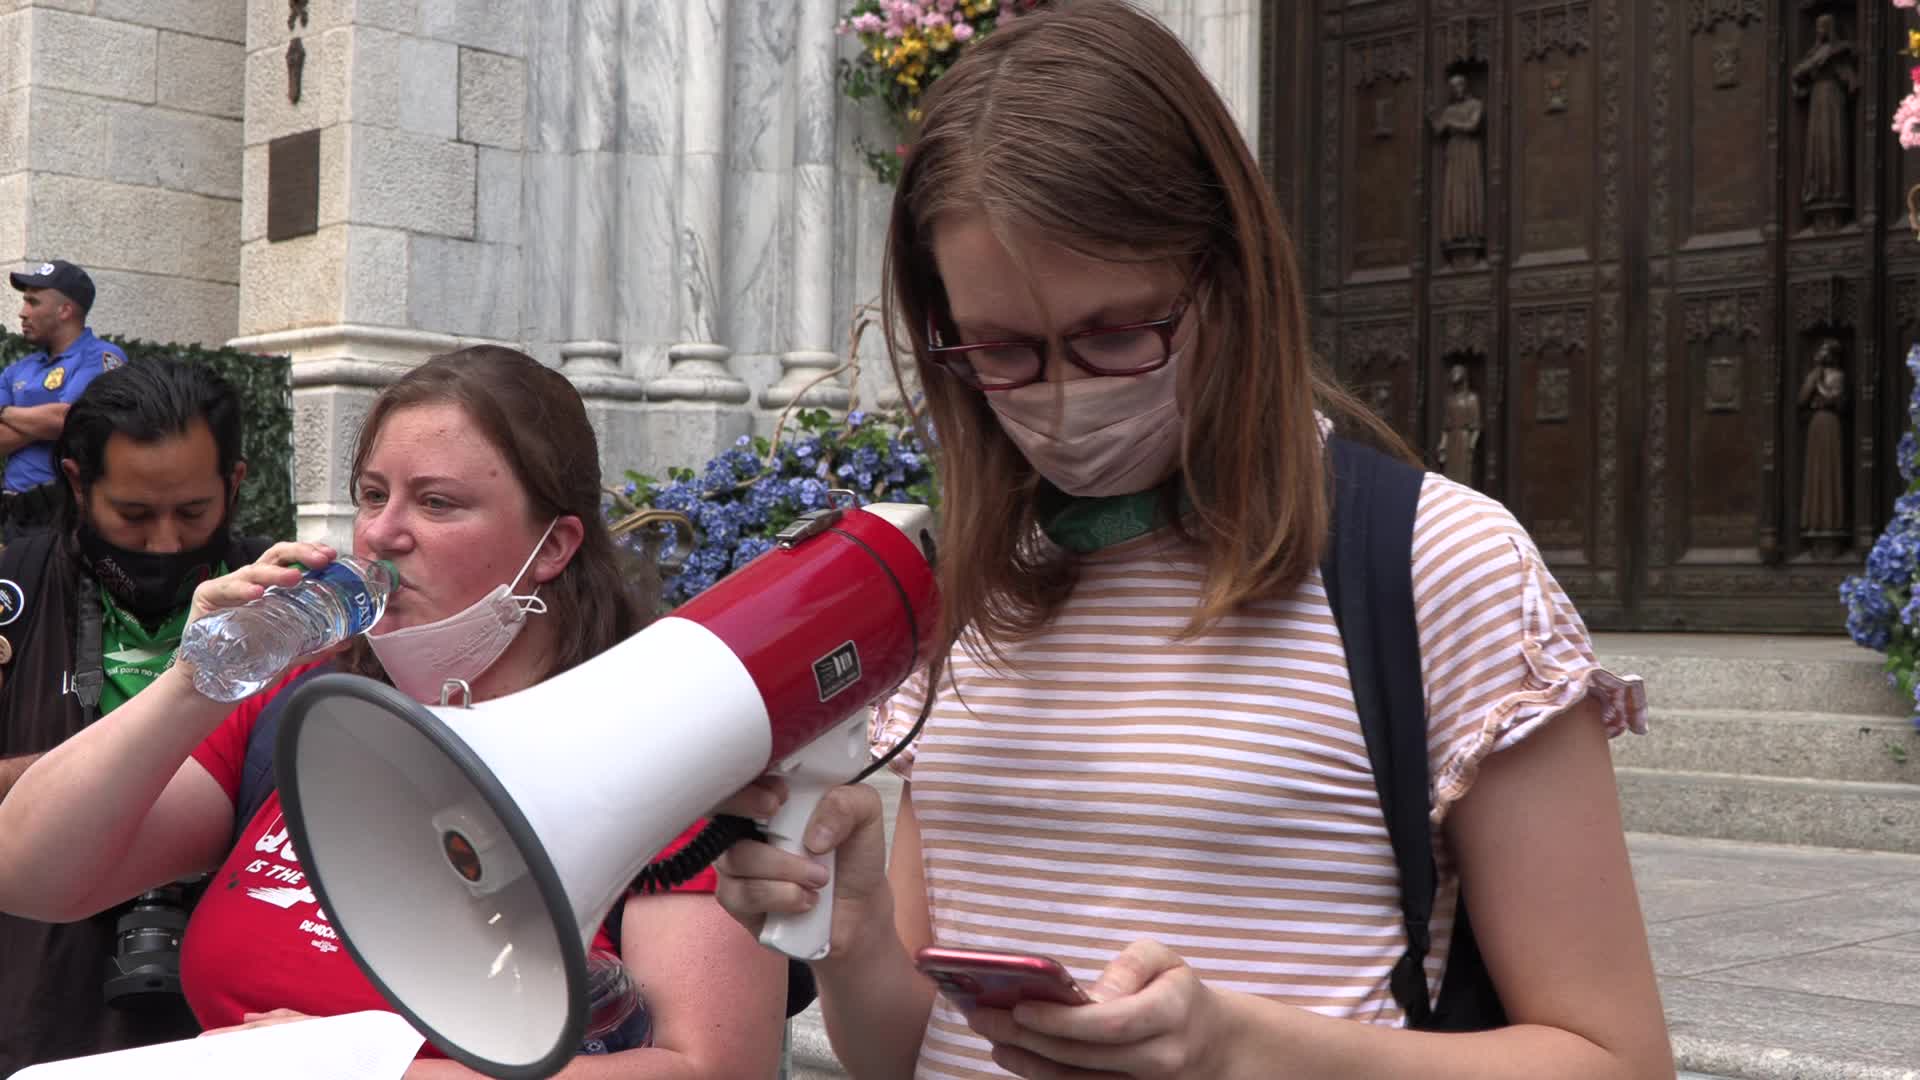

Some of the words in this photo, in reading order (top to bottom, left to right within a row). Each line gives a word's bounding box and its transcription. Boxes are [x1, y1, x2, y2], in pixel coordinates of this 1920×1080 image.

[141, 669, 153, 677] no
[245, 859, 269, 873] IS
[265, 864, 304, 885] THE
